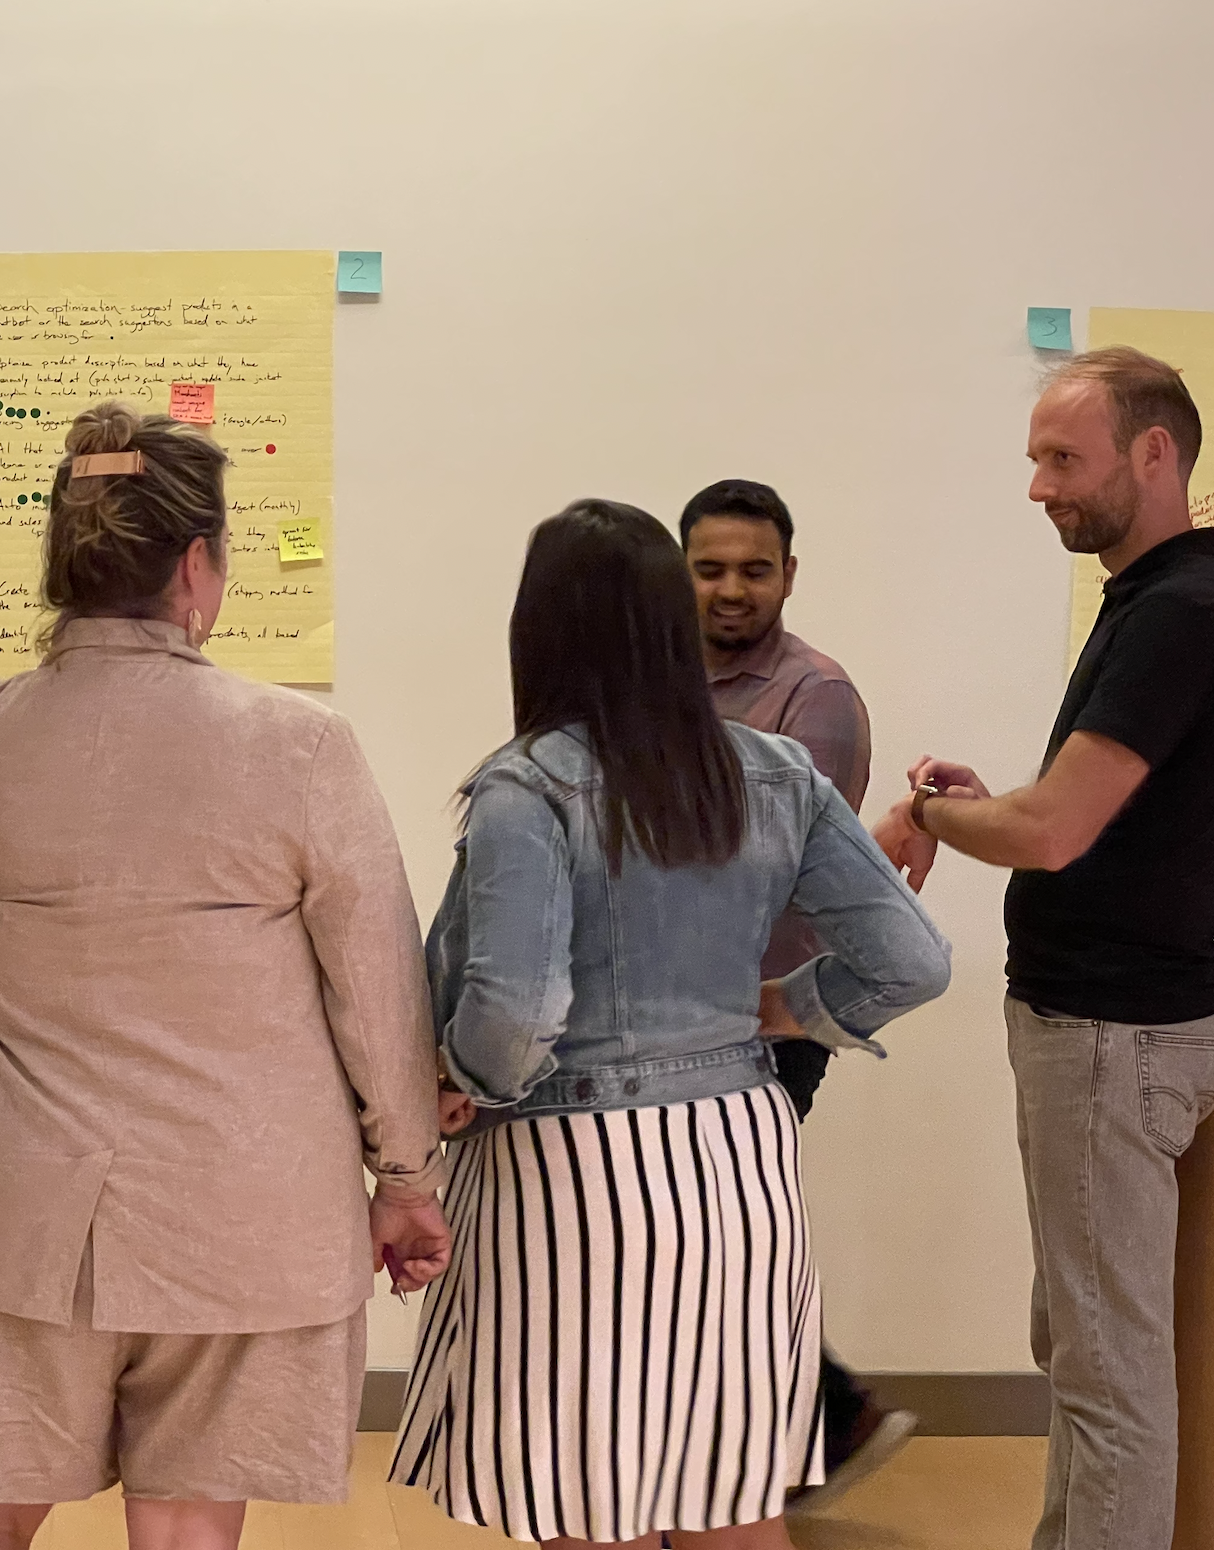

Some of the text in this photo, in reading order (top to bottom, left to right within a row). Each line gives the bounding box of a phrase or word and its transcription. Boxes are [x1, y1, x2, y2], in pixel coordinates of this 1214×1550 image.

[350, 257, 367, 280] 2
[47, 298, 121, 318] optimization
[131, 298, 171, 318] suggest
[58, 316, 71, 326] the
[184, 314, 208, 327] based
[236, 315, 257, 324] what
[1042, 316, 1058, 337] 3
[24, 443, 43, 454] that
[0, 600, 10, 610] the
[257, 626, 267, 638] all
